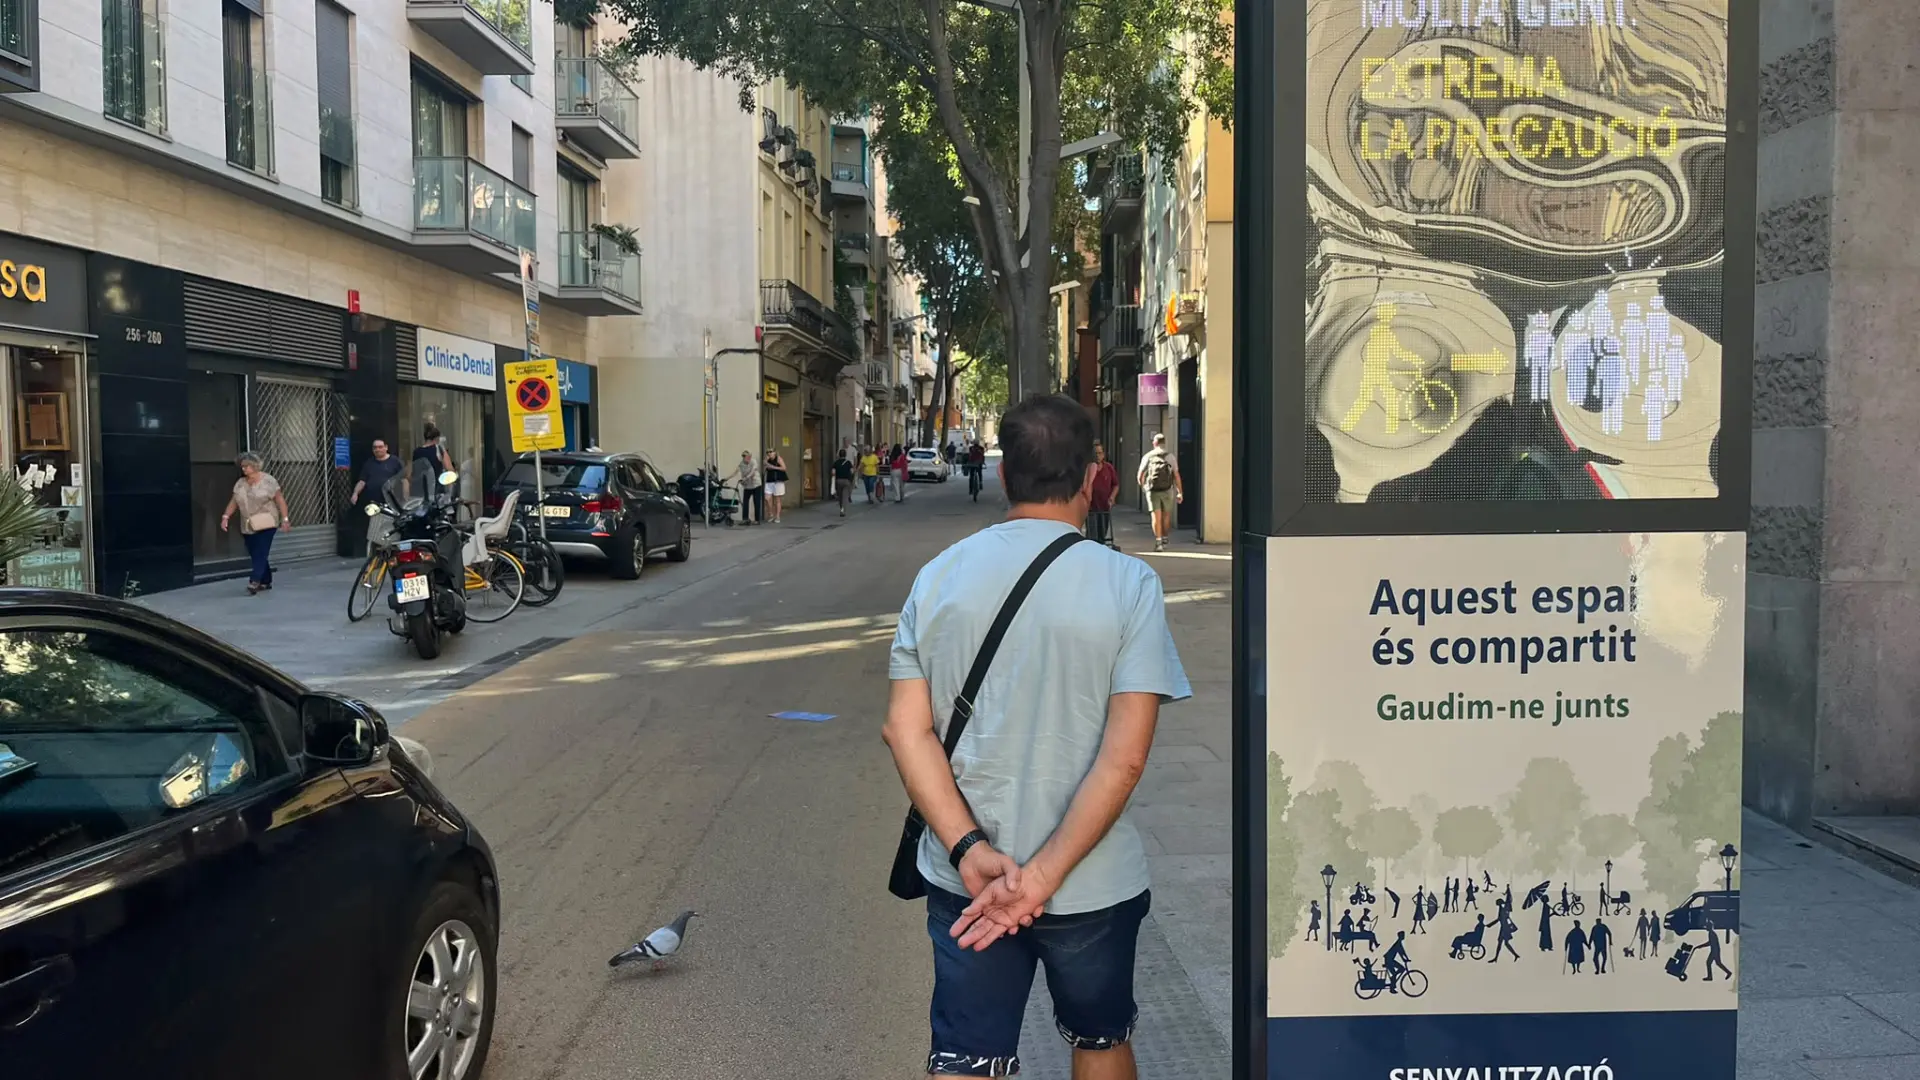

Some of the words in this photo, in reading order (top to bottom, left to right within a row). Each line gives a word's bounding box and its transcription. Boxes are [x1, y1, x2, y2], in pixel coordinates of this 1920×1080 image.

[1361, 56, 1566, 99] EXTREMA
[1361, 117, 1414, 159] LA
[1424, 105, 1679, 159] PRECAUCIÓ
[0, 259, 46, 302] sa
[425, 346, 461, 371] Clínica
[462, 353, 494, 376] Dental
[1369, 579, 1517, 625] Aquest
[1531, 574, 1638, 623] espai
[1372, 627, 1415, 665] és
[1430, 625, 1637, 674] compartit
[1376, 692, 1545, 721] Gaudim-ne
[1552, 691, 1630, 726] junts
